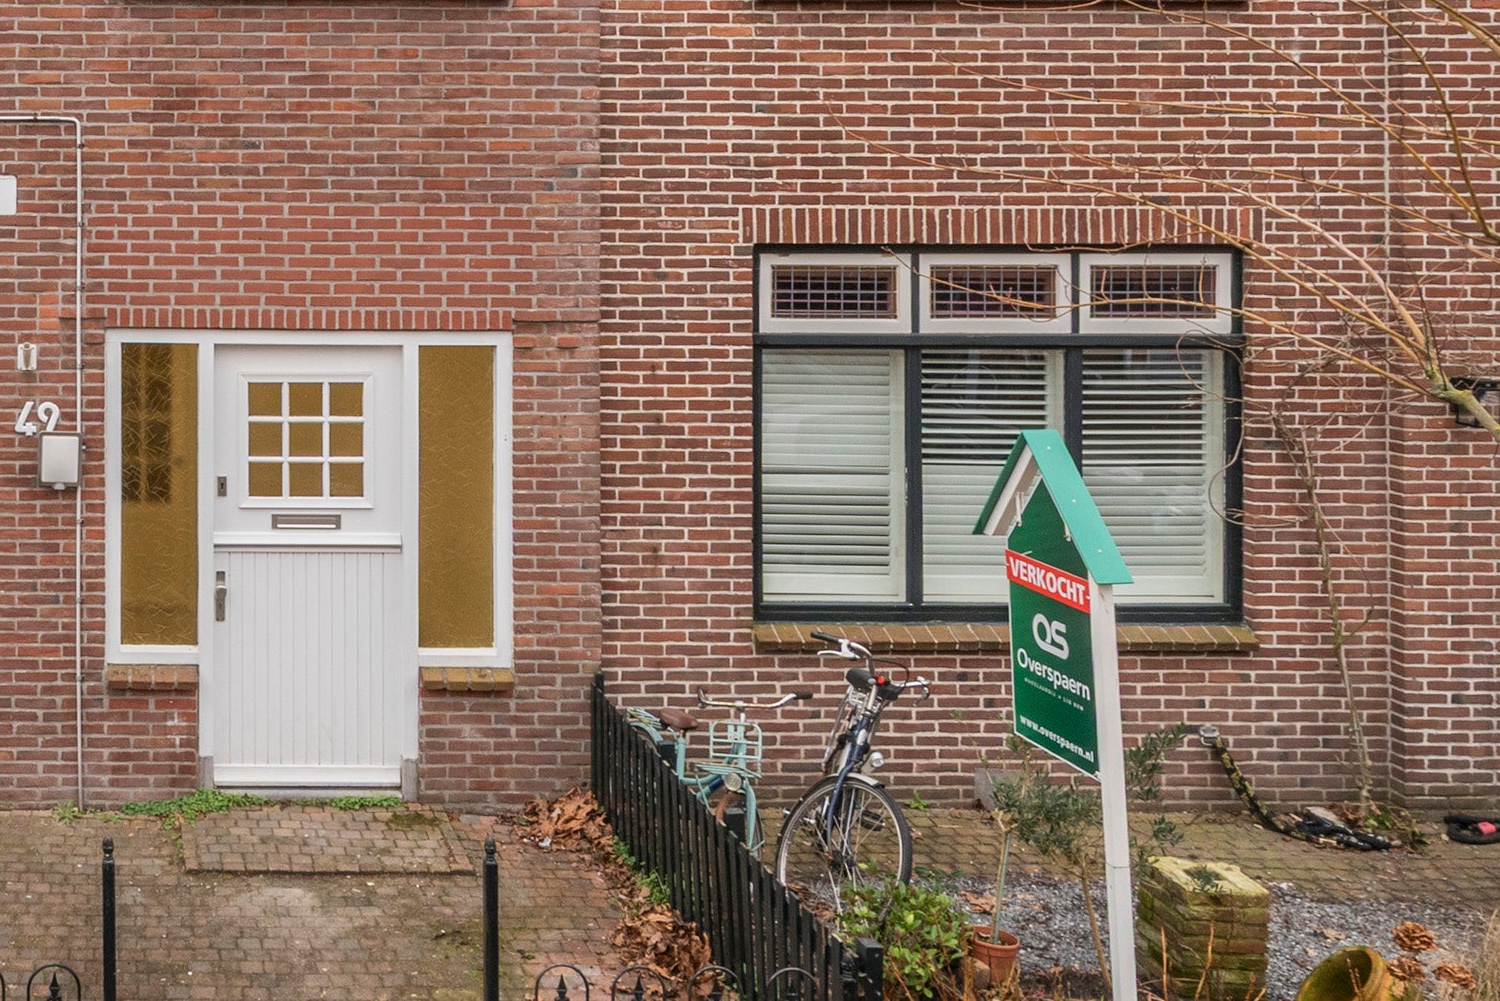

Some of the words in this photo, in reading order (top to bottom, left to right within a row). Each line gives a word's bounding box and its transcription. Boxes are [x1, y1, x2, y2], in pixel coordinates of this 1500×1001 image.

[14, 401, 60, 436] 49
[1009, 556, 1086, 606] VERKOCHT
[1017, 648, 1091, 701] Overspaern
[1019, 715, 1095, 763] www.overspaern.nl
